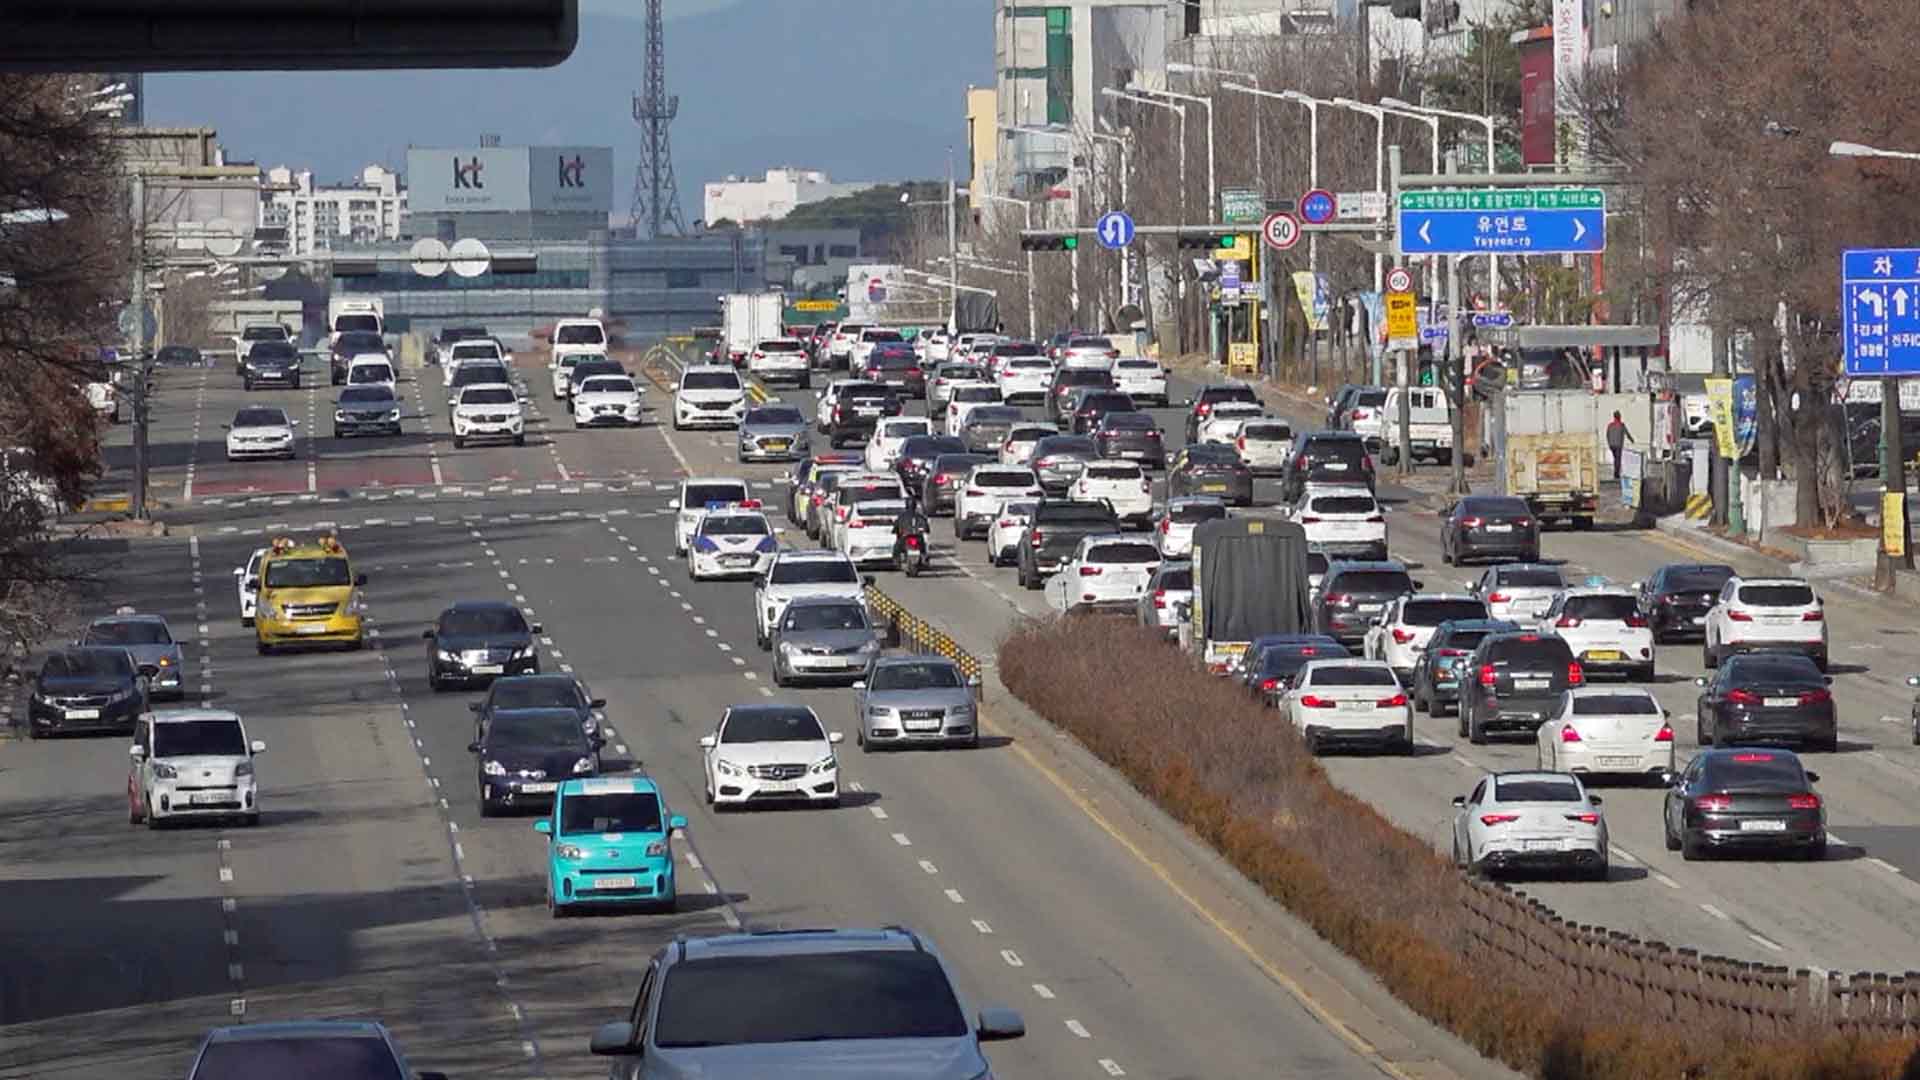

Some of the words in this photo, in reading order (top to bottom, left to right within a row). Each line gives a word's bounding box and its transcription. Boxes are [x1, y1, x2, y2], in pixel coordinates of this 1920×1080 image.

[1558, 8, 1576, 63] skylife
[454, 155, 484, 189] kt
[560, 154, 585, 188] kt
[1272, 222, 1291, 239] 60
[1477, 215, 1528, 233] 유연로
[1473, 236, 1532, 248] Yuyeon-ro
[1392, 275, 1407, 287] 60
